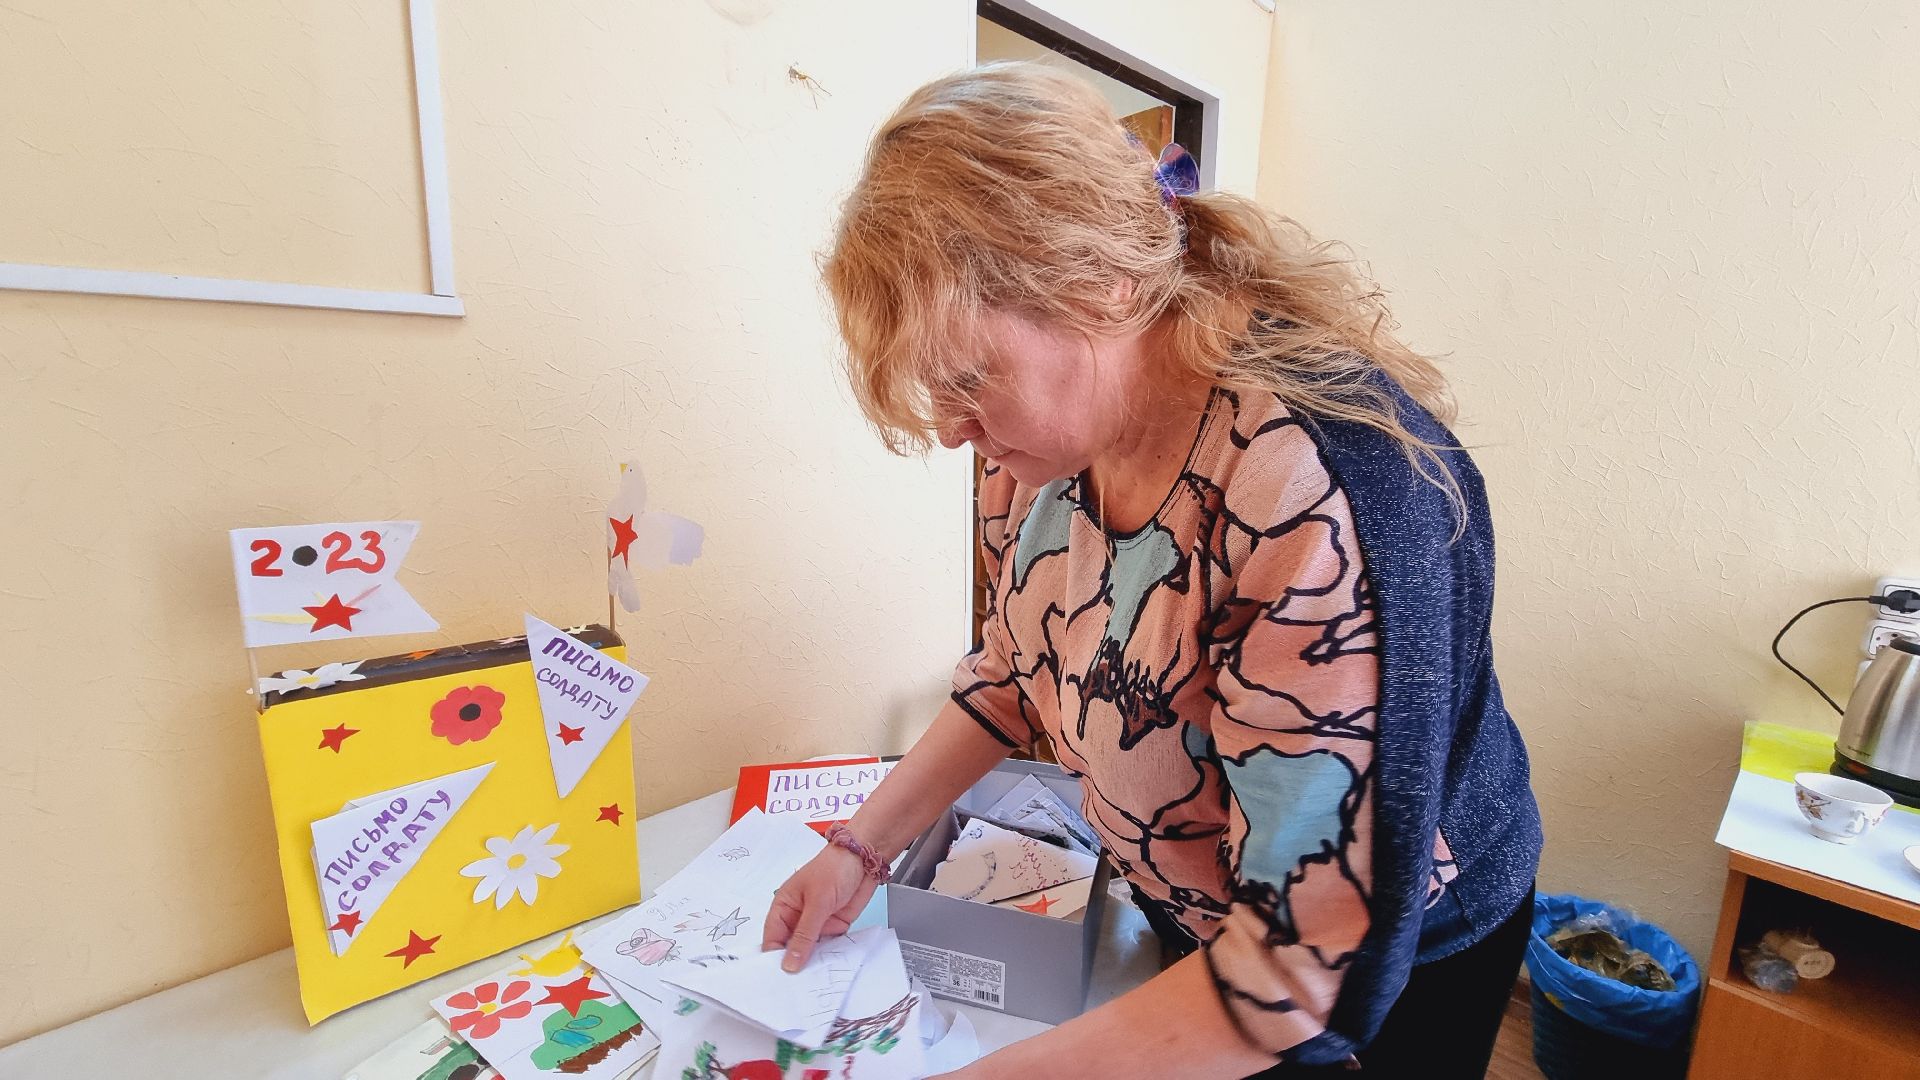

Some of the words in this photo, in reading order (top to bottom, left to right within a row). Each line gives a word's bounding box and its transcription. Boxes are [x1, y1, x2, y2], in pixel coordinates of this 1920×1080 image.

[542, 637, 634, 693] ПИСЬМО
[537, 668, 618, 720] СОЛДАТУ
[769, 791, 871, 819] солда
[324, 797, 408, 885] ПИСЬМО
[338, 790, 451, 911] СОЛДАТУ
